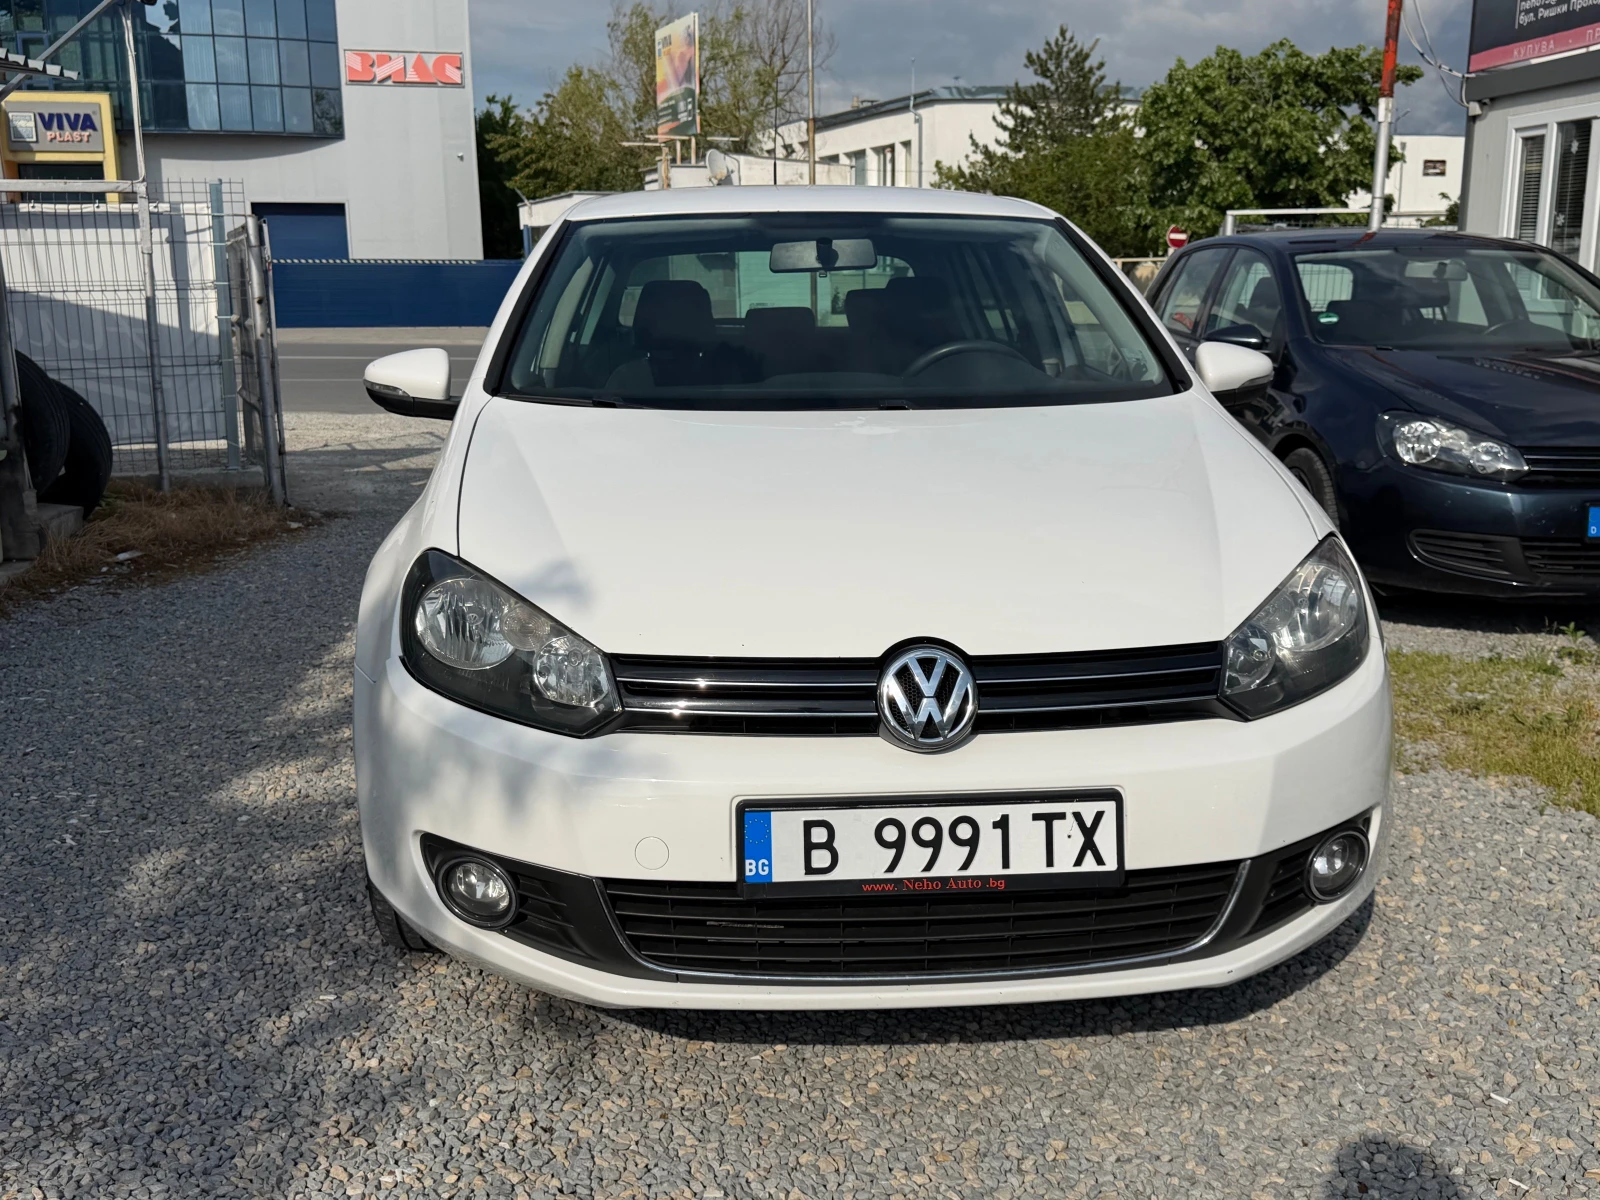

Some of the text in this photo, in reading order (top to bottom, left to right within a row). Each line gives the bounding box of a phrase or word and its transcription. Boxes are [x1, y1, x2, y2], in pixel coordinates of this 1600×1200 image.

[1519, 0, 1600, 26] бул. Ришки Прохо
[1513, 39, 1555, 59] КУПУВА
[38, 112, 98, 131] VIVA
[47, 131, 90, 142] PLAST
[1590, 526, 1597, 534] D
[885, 650, 973, 744] VW
[803, 810, 1106, 876] B 9991 TX
[745, 859, 769, 876] BG
[862, 877, 1005, 892] www. Neho Auto .bg
